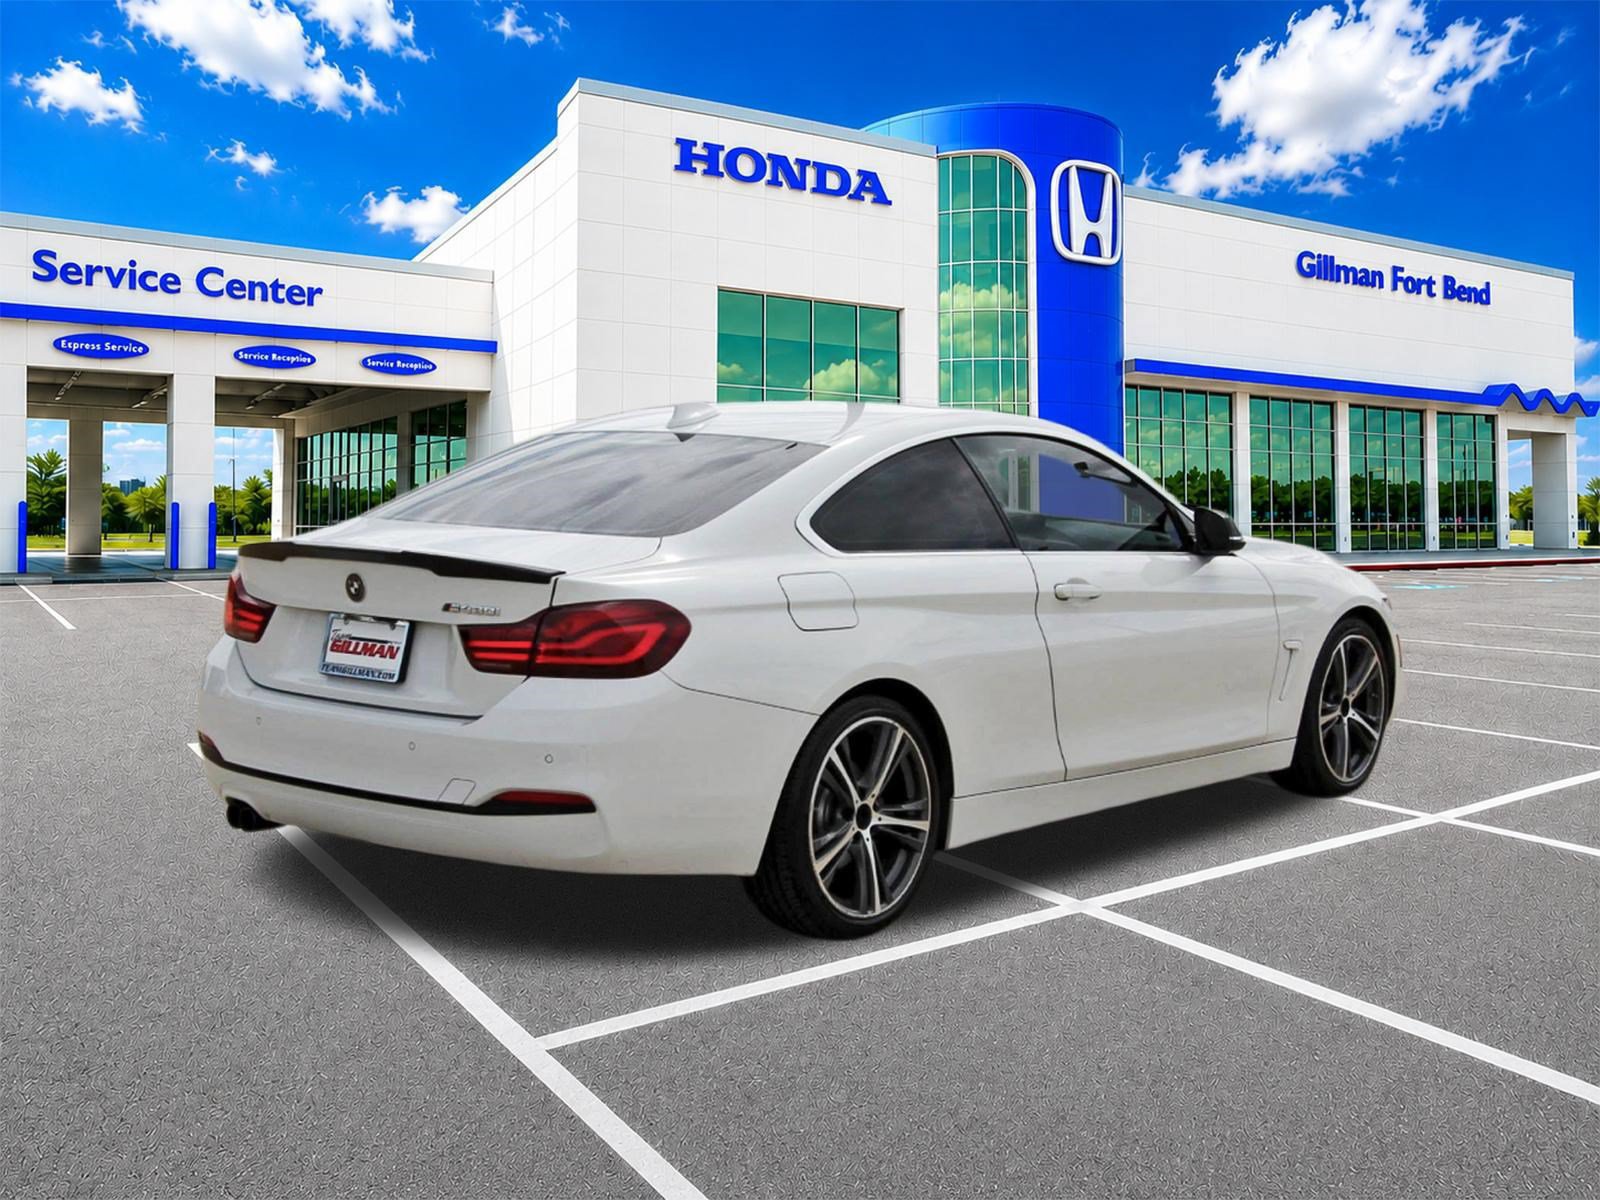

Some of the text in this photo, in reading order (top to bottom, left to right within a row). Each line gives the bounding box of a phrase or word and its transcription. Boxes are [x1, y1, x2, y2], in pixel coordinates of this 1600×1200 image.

[674, 137, 892, 206] HONDA
[32, 249, 324, 307] Service Center
[1296, 250, 1491, 305] Gillman Fort Bend
[104, 342, 144, 354] Service
[238, 351, 270, 361] Service
[367, 358, 395, 369] Service
[329, 639, 400, 660] GILLMAN
